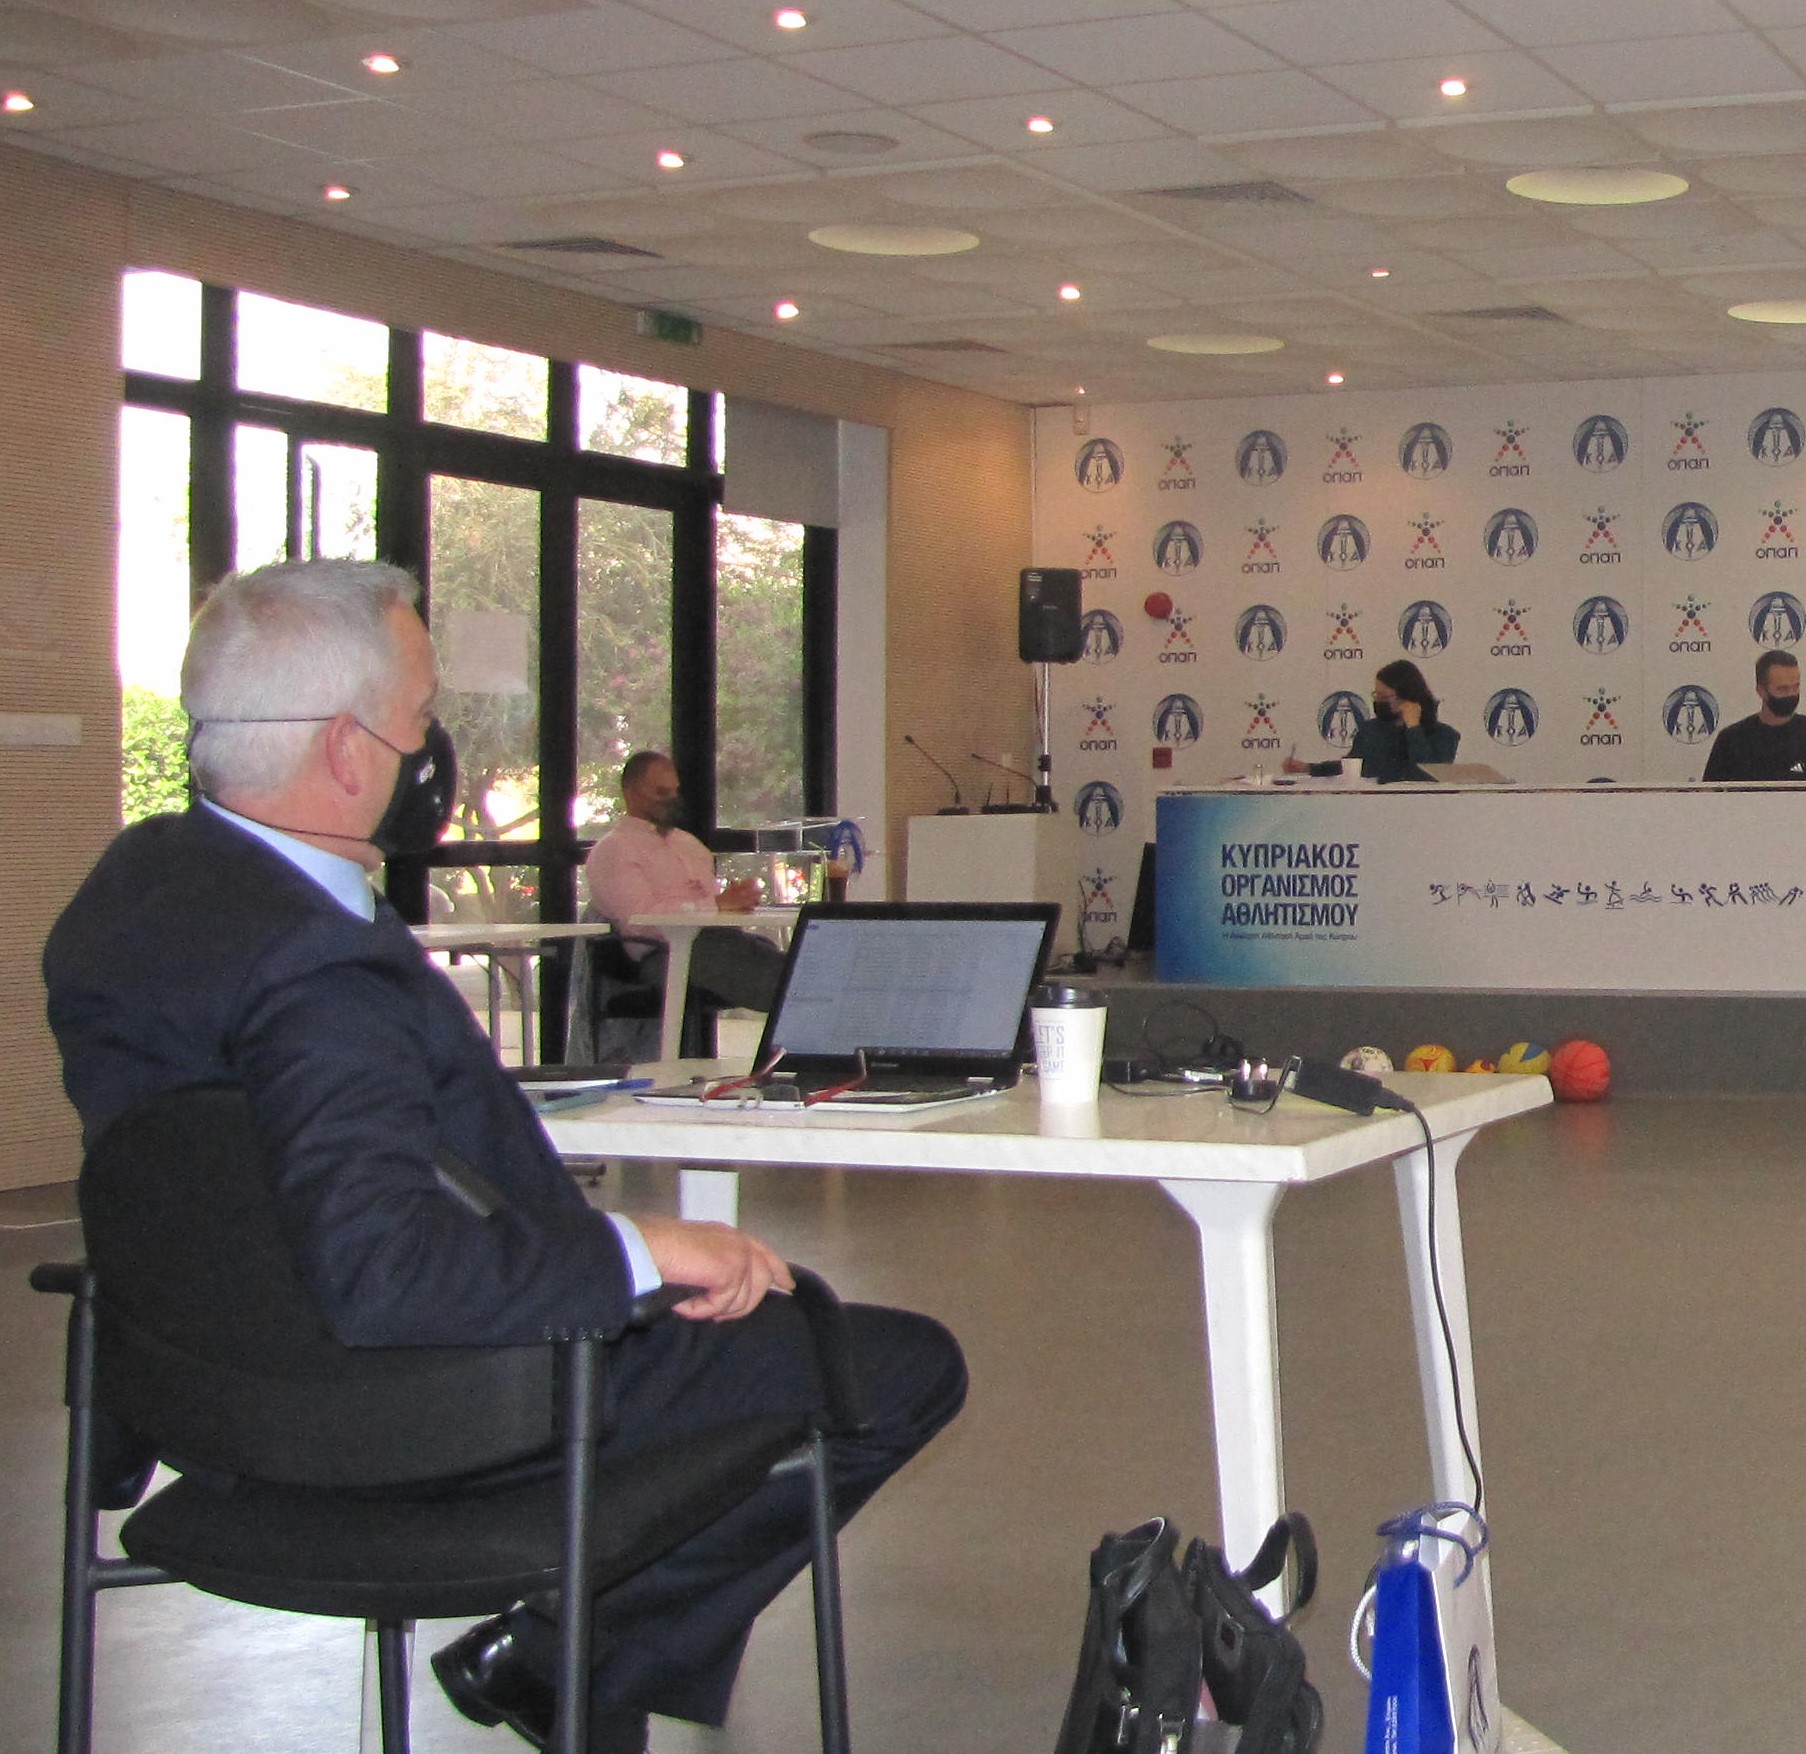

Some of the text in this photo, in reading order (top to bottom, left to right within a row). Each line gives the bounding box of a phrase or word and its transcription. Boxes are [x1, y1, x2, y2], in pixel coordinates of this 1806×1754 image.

[1222, 843, 1360, 869] ΚΥΠΡΙΑΚΟΣ
[1221, 874, 1359, 897] ΟΡΓΑΝΙΣΜΟΣ
[1221, 902, 1359, 926] ΑΘΛΗΤΙΣΜΟΥ
